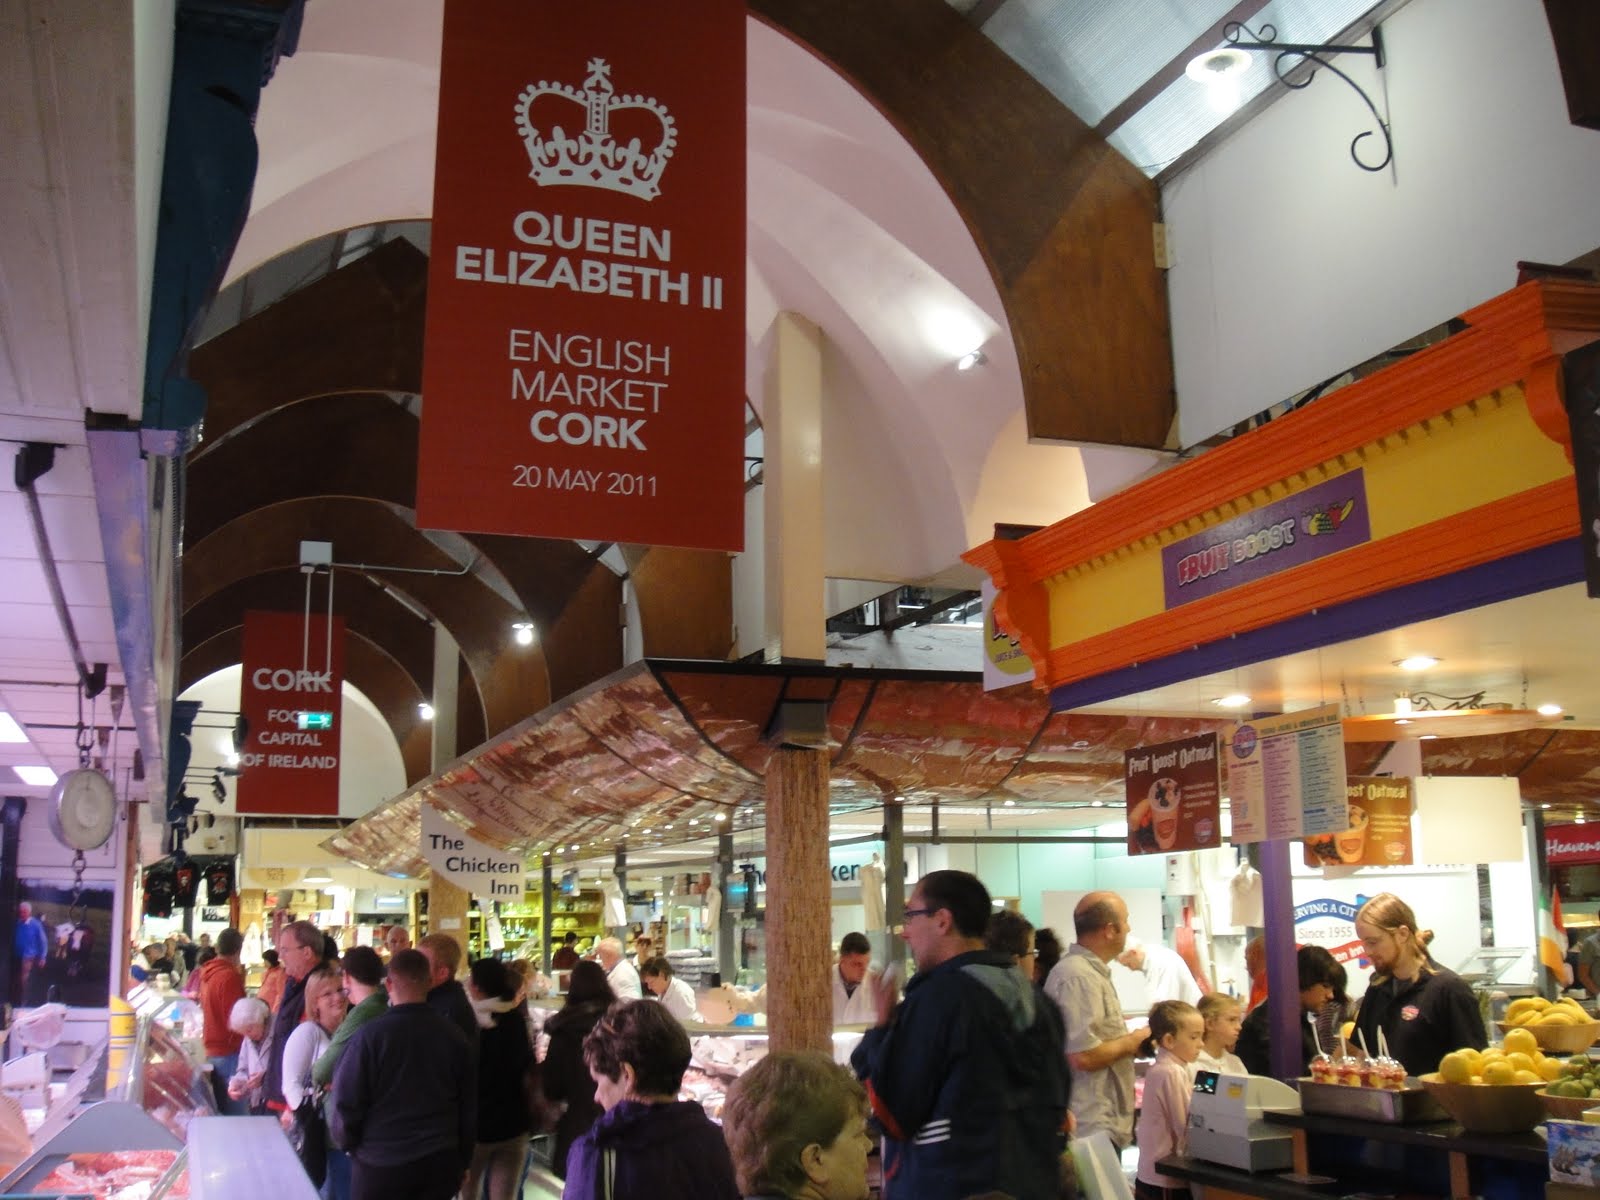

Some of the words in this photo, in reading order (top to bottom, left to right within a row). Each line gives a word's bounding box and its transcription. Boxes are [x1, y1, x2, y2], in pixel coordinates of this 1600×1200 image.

[513, 210, 671, 262] QUEEN
[455, 245, 690, 305] ELIZABETH
[702, 276, 723, 310] II
[509, 329, 670, 376] ENGLISH
[511, 368, 669, 413] MARKET
[530, 410, 647, 451] CORK
[512, 465, 541, 488] 20
[547, 467, 603, 492] MAY
[607, 473, 656, 497] 2011
[1177, 541, 1230, 587] FRUIT
[1232, 518, 1296, 564] BOOST
[252, 667, 333, 693] CORK
[267, 709, 299, 724] FOO
[258, 731, 322, 747] CAPITAL
[243, 753, 265, 767] OF
[268, 754, 337, 770] IRELAND
[1180, 741, 1215, 769] Oatmeal
[429, 834, 465, 851] The
[446, 856, 519, 874] Chicken
[491, 879, 519, 895] Inn
[1330, 903, 1338, 913] A
[1298, 927, 1325, 939] Since
[1328, 926, 1353, 938] 1955
